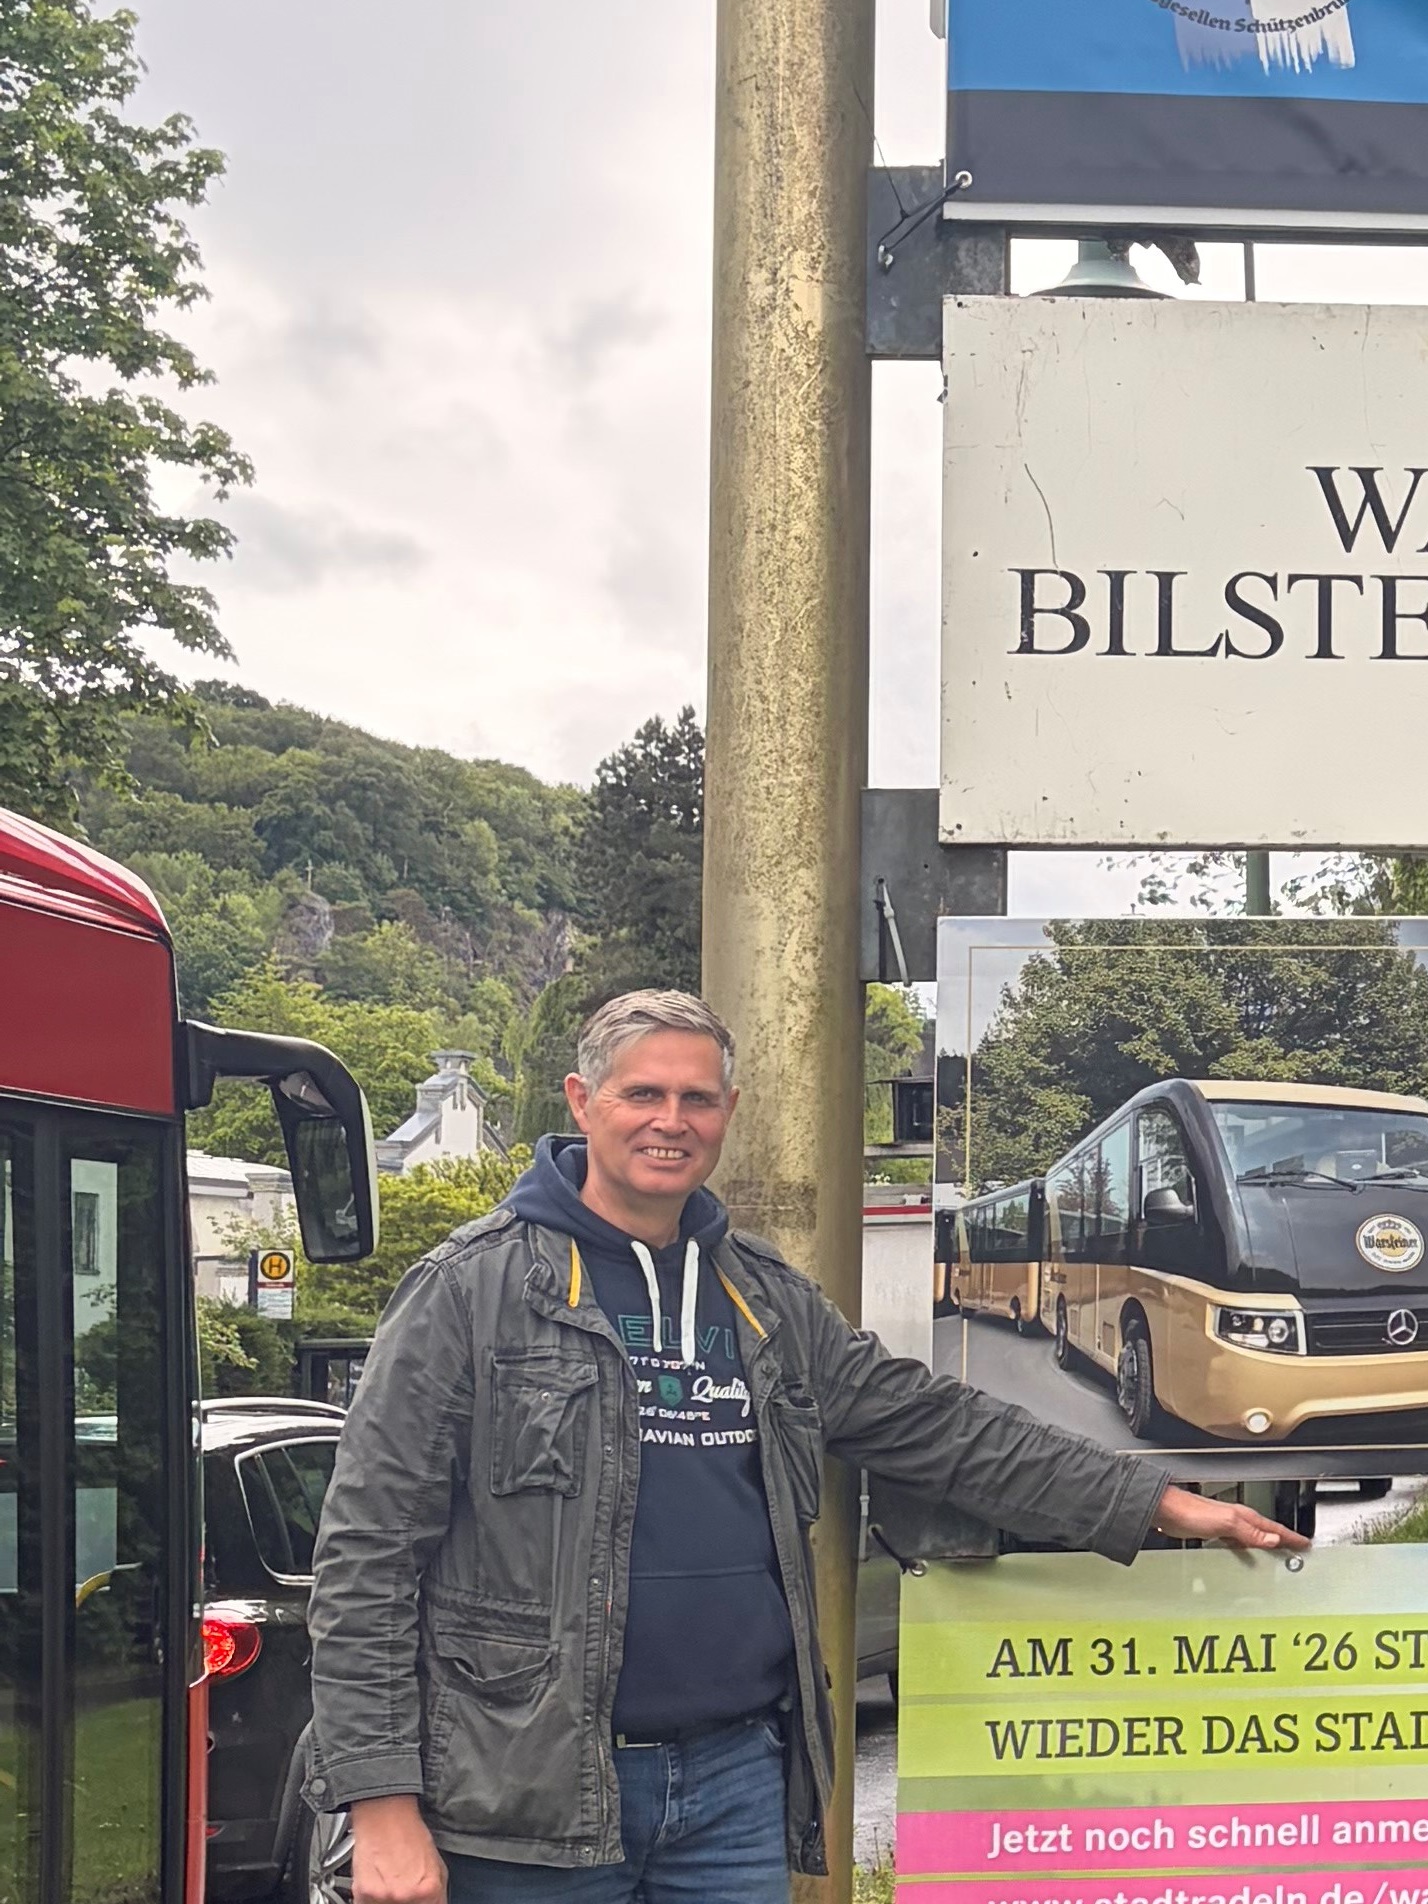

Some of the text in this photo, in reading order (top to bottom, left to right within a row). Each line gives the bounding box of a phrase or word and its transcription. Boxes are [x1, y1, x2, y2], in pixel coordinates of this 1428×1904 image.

[690, 1375, 751, 1418] Quality
[639, 1427, 695, 1447] AVIAN
[985, 1637, 1074, 1678] AM
[1090, 1637, 1157, 1676] 31.
[1172, 1633, 1277, 1675] MAI
[984, 1716, 1188, 1760] WIEDER
[1201, 1713, 1300, 1755] DAS
[987, 1822, 1073, 1859] Jetzt
[1085, 1818, 1175, 1852] noch
[1187, 1814, 1319, 1849] schnell
